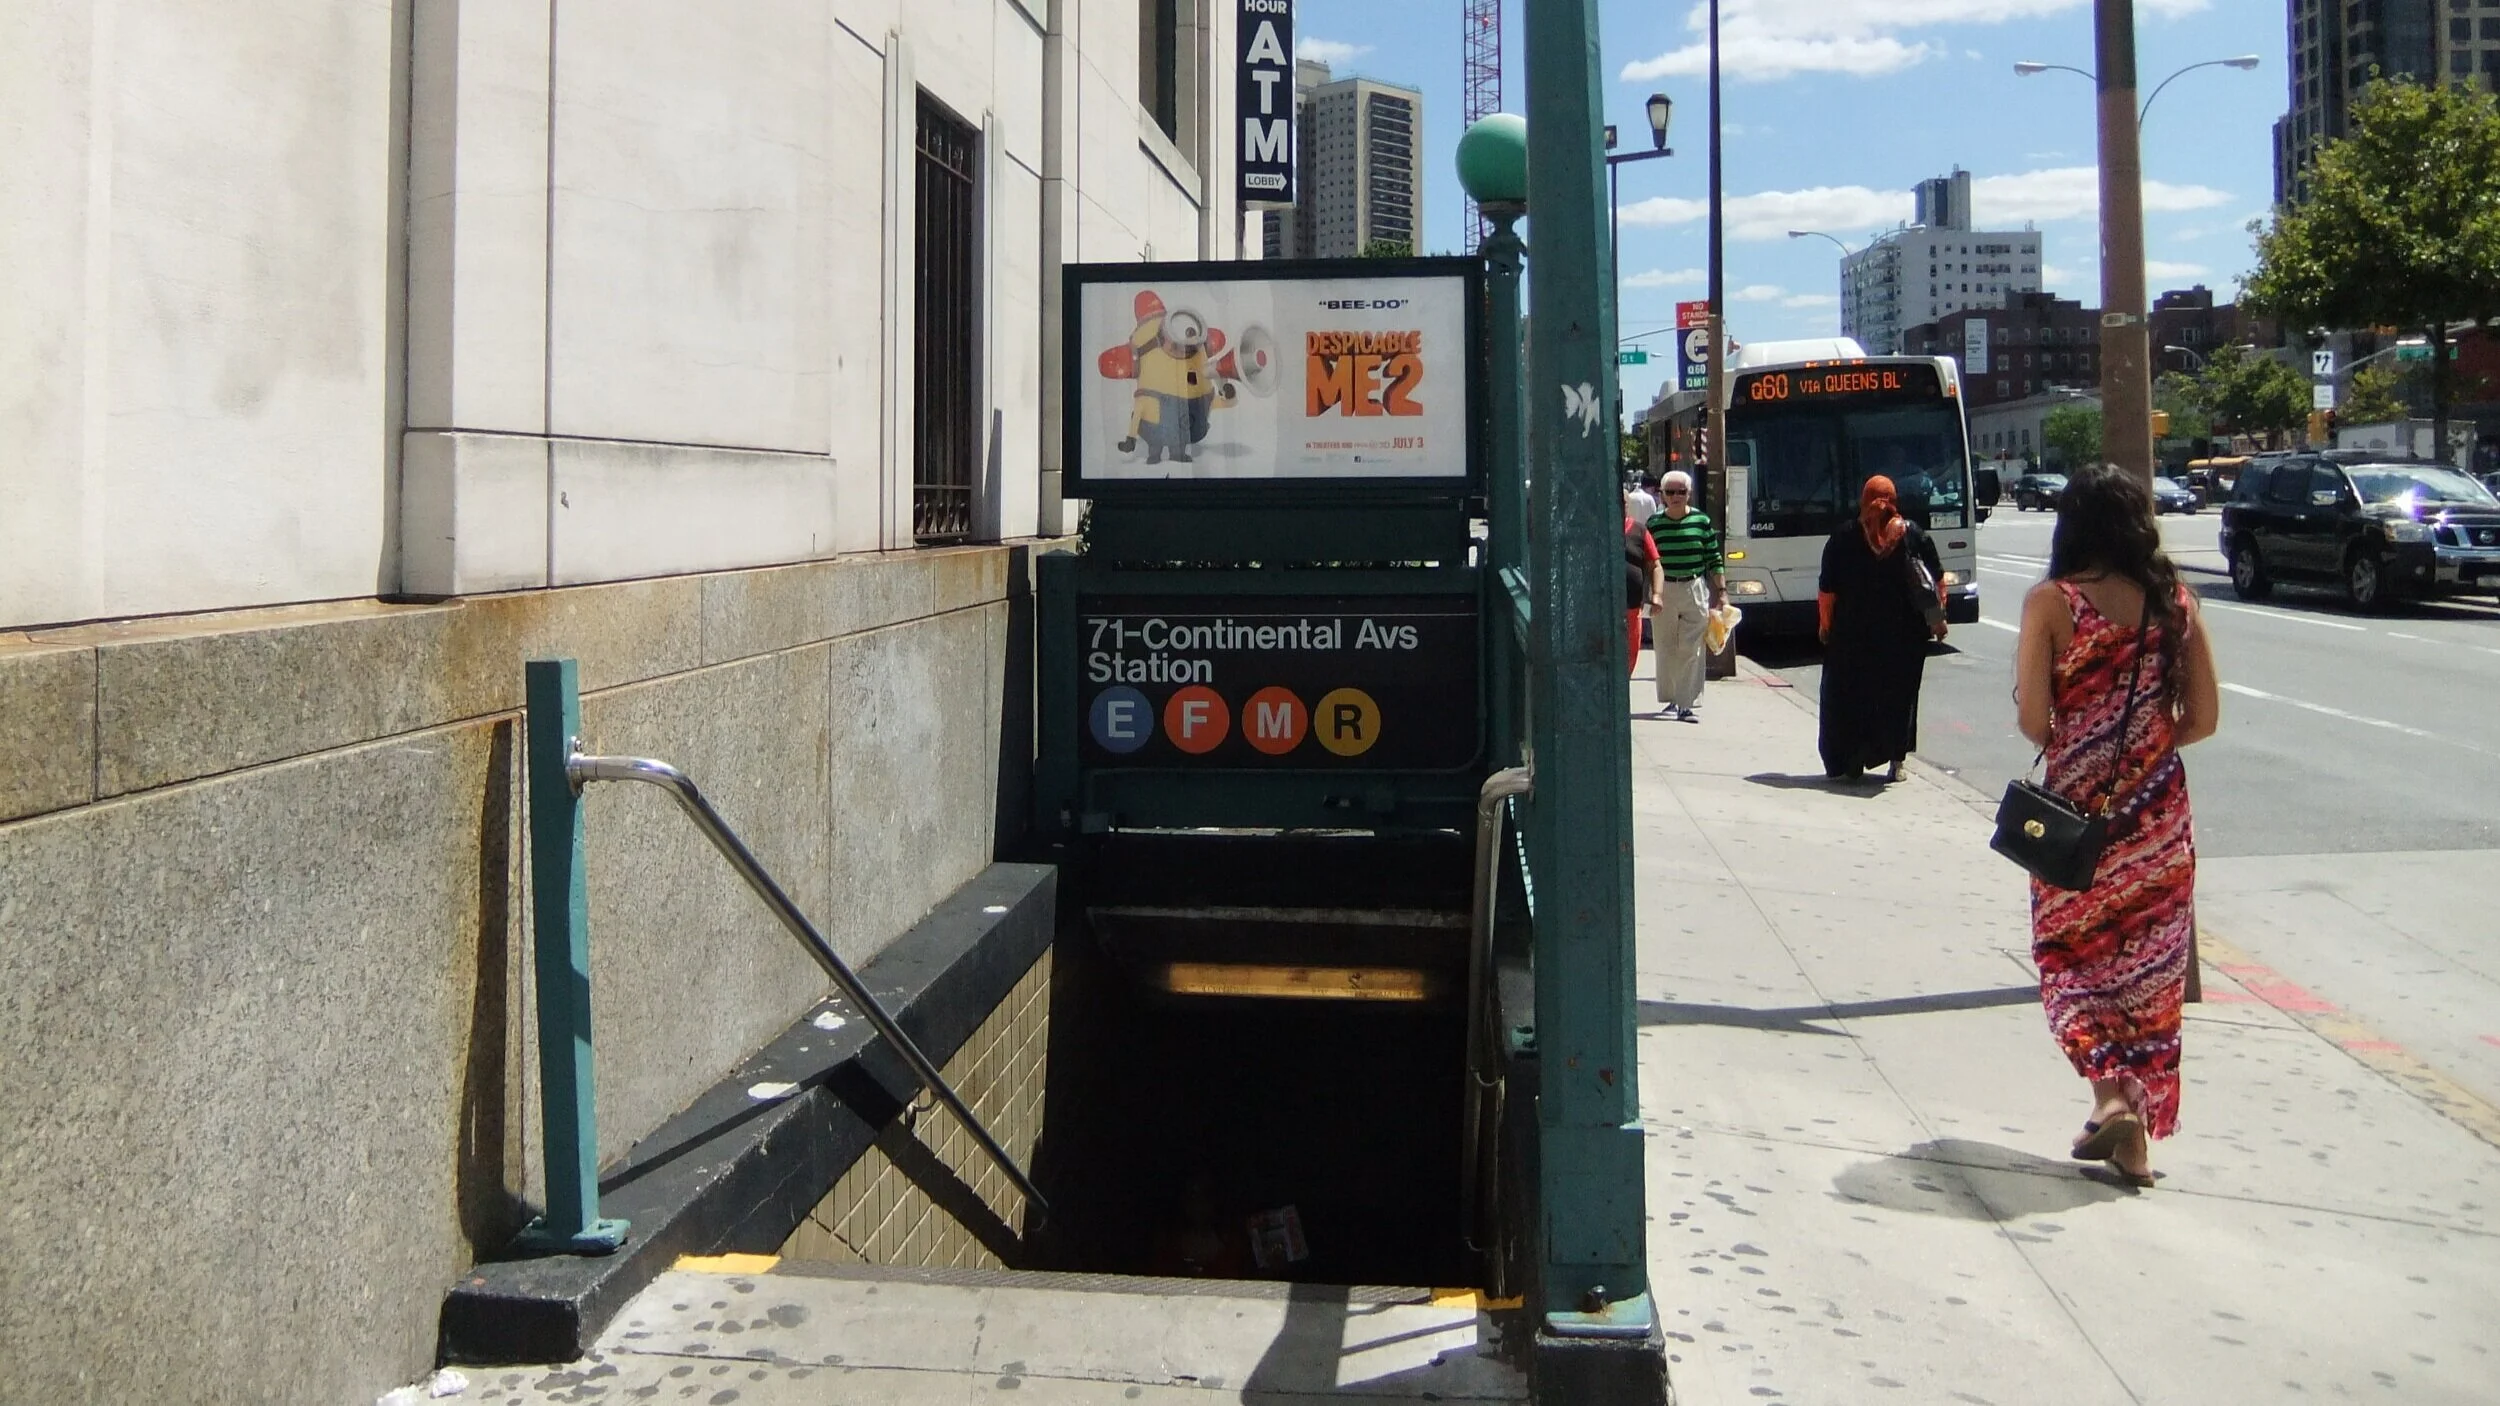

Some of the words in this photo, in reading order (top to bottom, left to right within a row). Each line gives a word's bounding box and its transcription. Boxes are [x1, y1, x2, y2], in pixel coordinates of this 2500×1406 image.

[1245, 0, 1287, 14] HOUR
[1245, 20, 1288, 164] ATM
[1248, 175, 1281, 187] LOBBY
[1306, 330, 1422, 355] DESPICABLE
[1687, 364, 1706, 375] Q60
[1751, 373, 1789, 400] Q60
[1800, 380, 1821, 393] VIA
[1825, 372, 1878, 392] QUEENS
[1883, 371, 1901, 389] BL
[1392, 436, 1414, 449] JULY
[1417, 436, 1424, 449] 3
[1087, 618, 1341, 651] 71-Continental
[1355, 618, 1419, 650] Avs
[1087, 652, 1213, 683] Station
[1107, 700, 1136, 738] E
[1182, 700, 1210, 738] F
[1256, 702, 1292, 739] M
[1333, 703, 1363, 740] R
